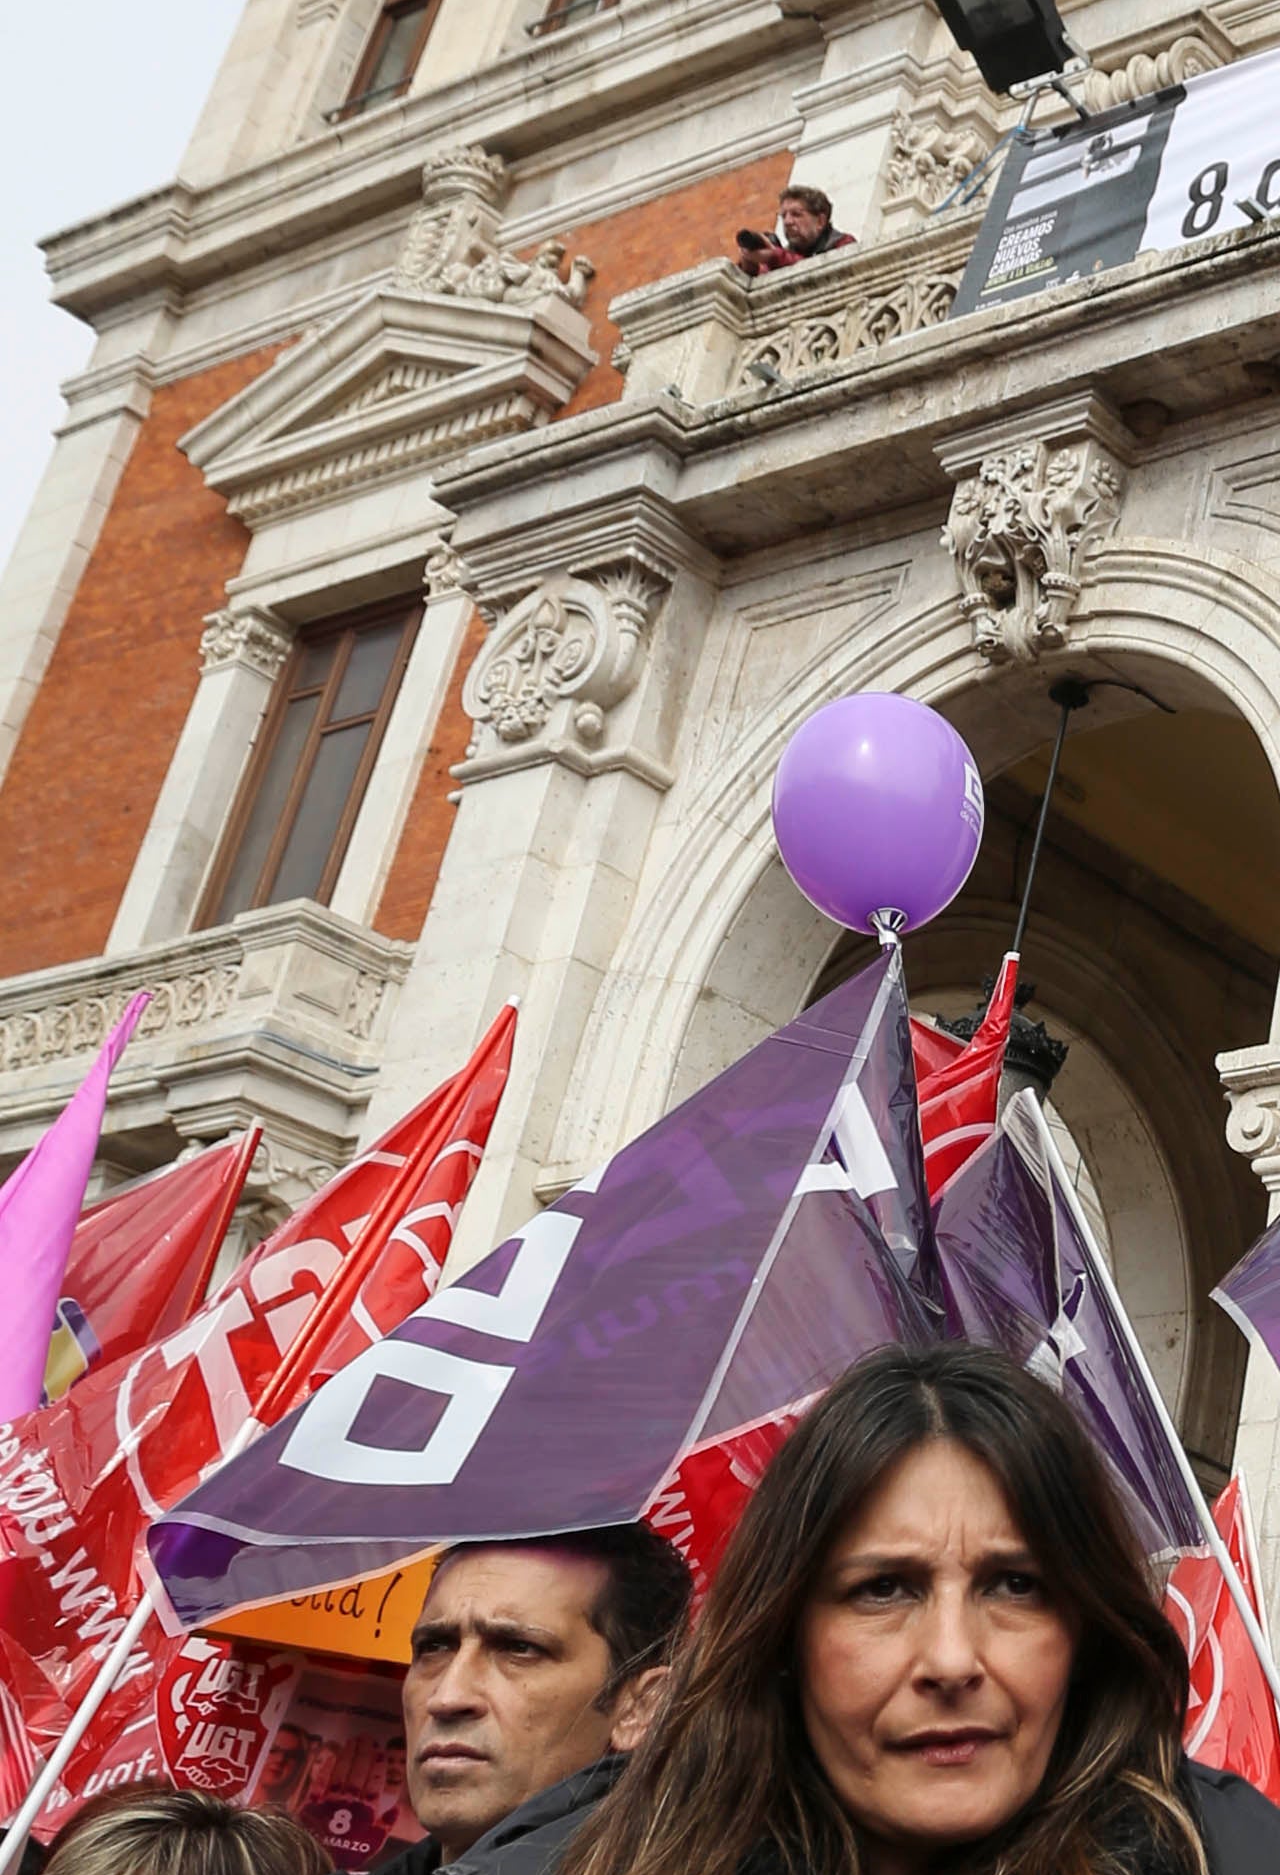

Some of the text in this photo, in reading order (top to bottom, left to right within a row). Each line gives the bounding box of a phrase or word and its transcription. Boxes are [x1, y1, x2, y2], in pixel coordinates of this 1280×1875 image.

[1181, 161, 1229, 239] 8
[200, 1657, 265, 1695] UGT
[183, 1725, 258, 1764] UGT
[328, 1808, 353, 1836] 8
